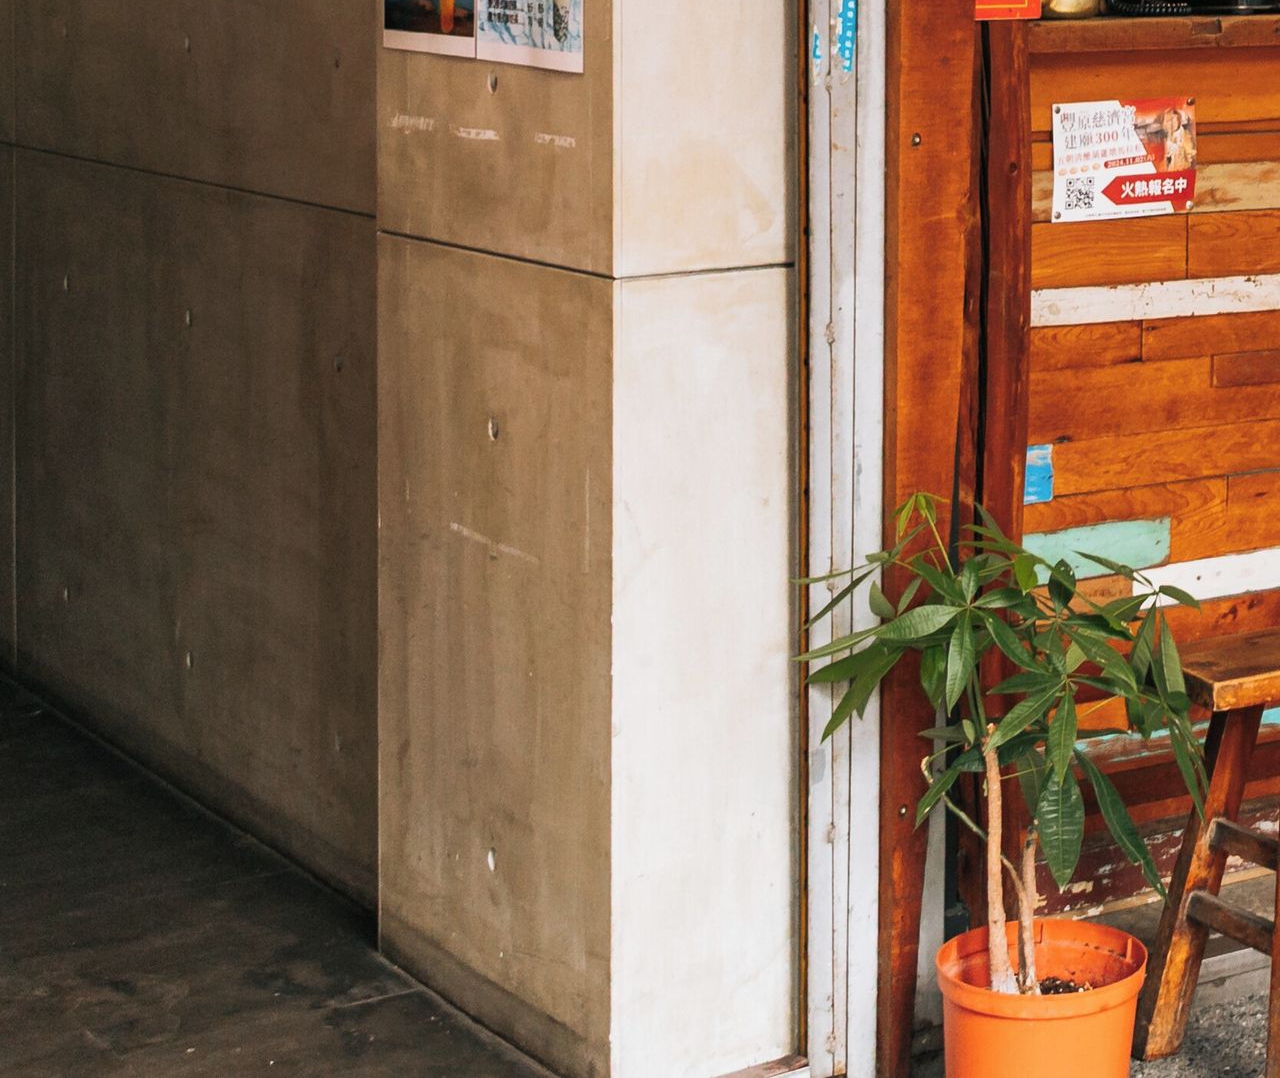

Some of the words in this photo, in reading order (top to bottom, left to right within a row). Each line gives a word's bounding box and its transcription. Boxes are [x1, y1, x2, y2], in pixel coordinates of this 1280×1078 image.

[1120, 177, 1188, 199] 火熱報名中
